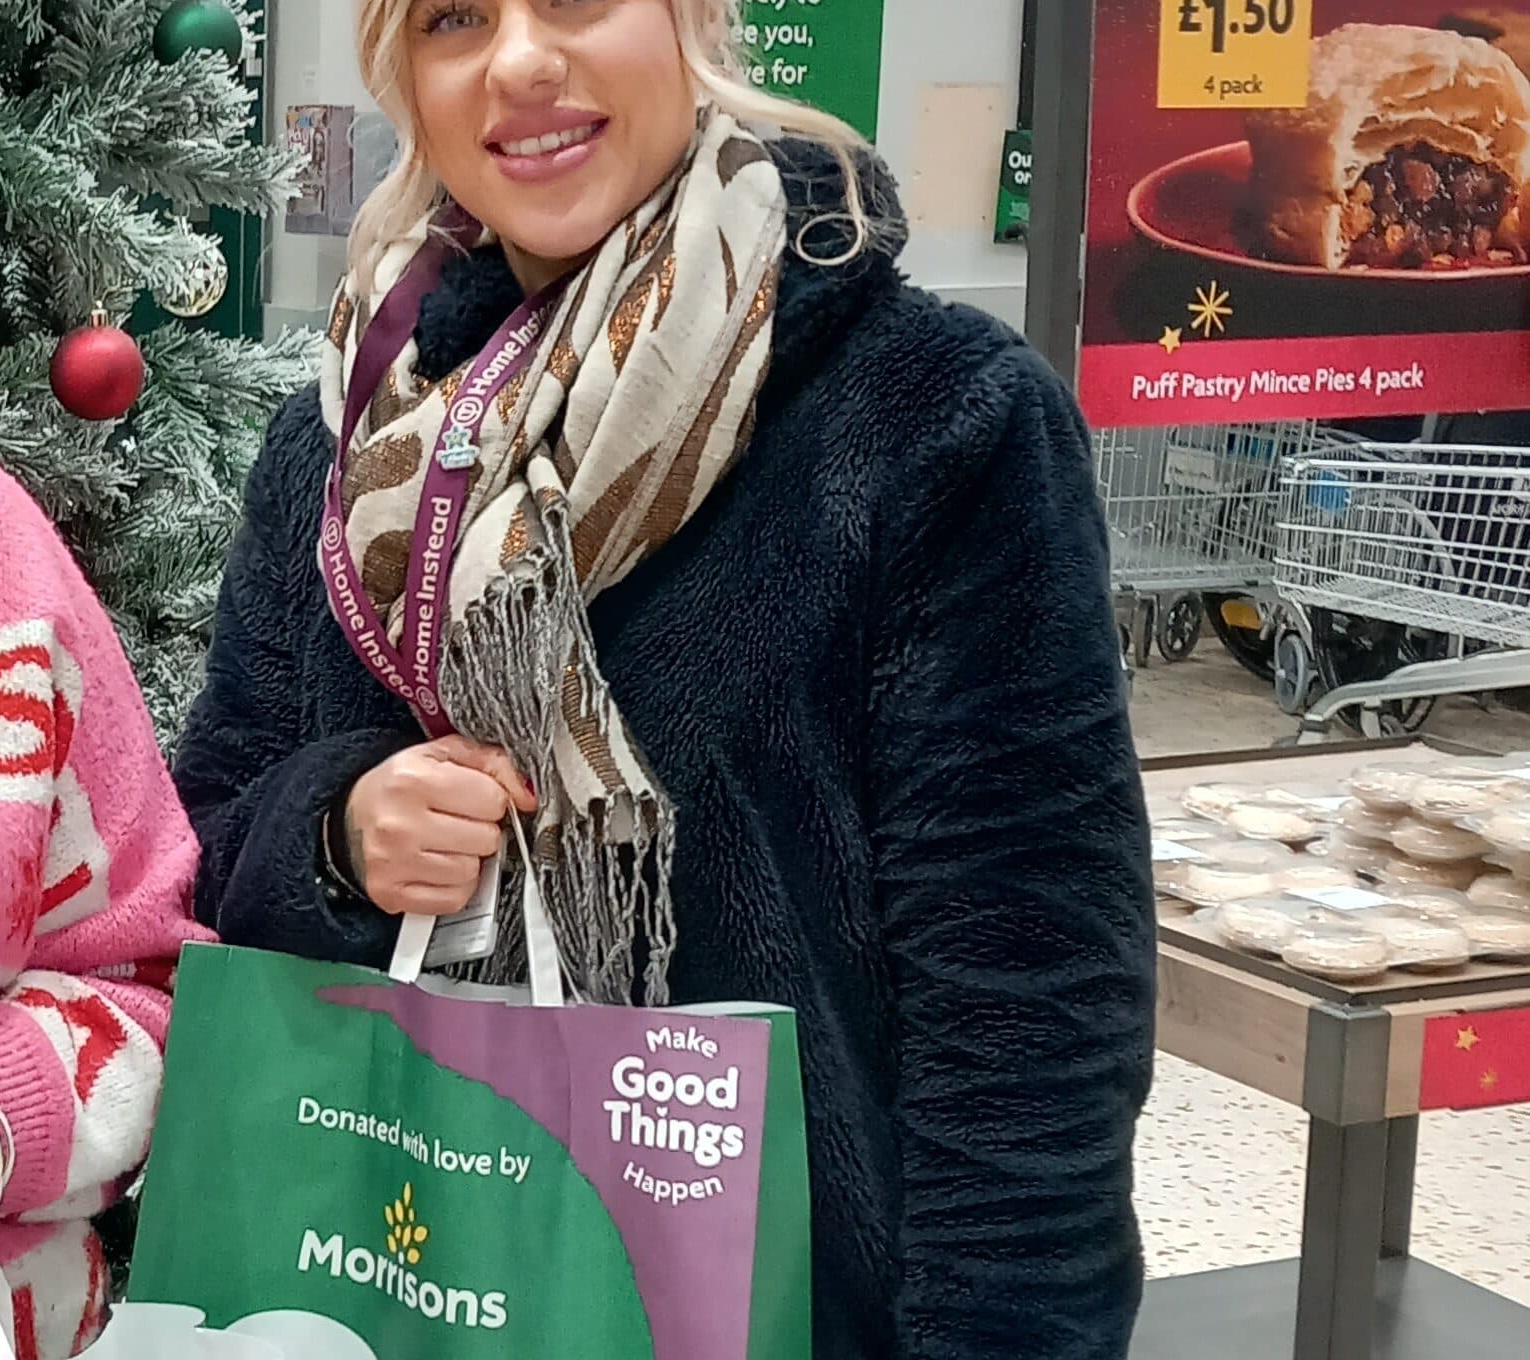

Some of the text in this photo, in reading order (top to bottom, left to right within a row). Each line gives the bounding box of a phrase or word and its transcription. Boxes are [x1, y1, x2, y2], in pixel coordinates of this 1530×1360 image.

[730, 24, 813, 52] ee you,
[771, 58, 808, 85] for
[1203, 73, 1263, 101] 4 pack
[466, 340, 523, 396] Home
[1131, 361, 1425, 403] Puff Pastry Mince Pies 4 pack
[415, 496, 452, 685] Home Instead
[329, 549, 415, 699] Home Instea
[646, 1026, 719, 1058] Make
[611, 1055, 741, 1110] Good
[297, 1096, 531, 1183] Donated with love by
[603, 1100, 745, 1168] Things
[622, 1160, 724, 1207] Happen
[297, 1228, 508, 1329] Morrisons
